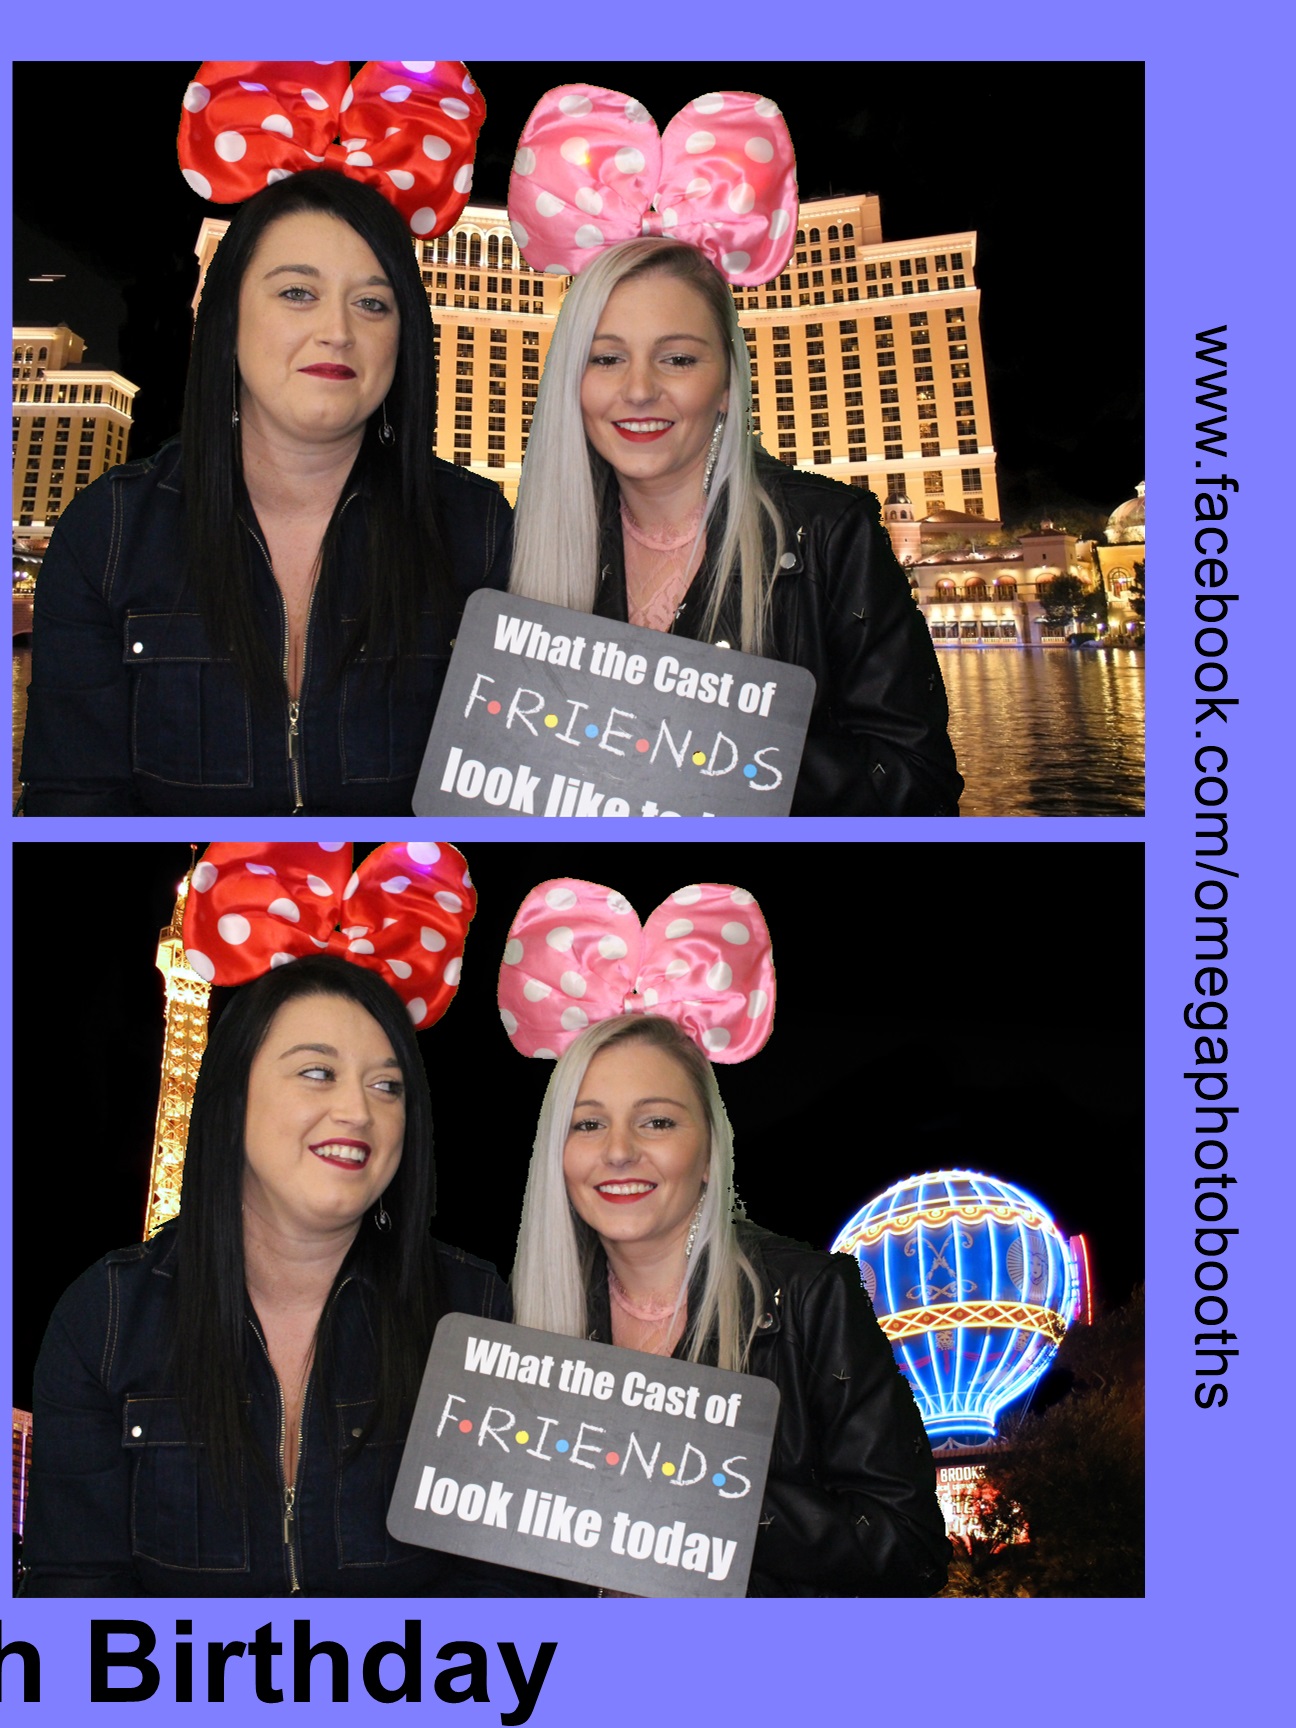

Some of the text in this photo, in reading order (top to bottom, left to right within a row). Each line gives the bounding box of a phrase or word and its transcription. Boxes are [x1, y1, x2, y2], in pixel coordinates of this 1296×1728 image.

[492, 613, 778, 718] What the Cast of
[439, 746, 542, 816] look
[463, 1336, 744, 1428] What the Cast of
[413, 1465, 738, 1581] look like today
